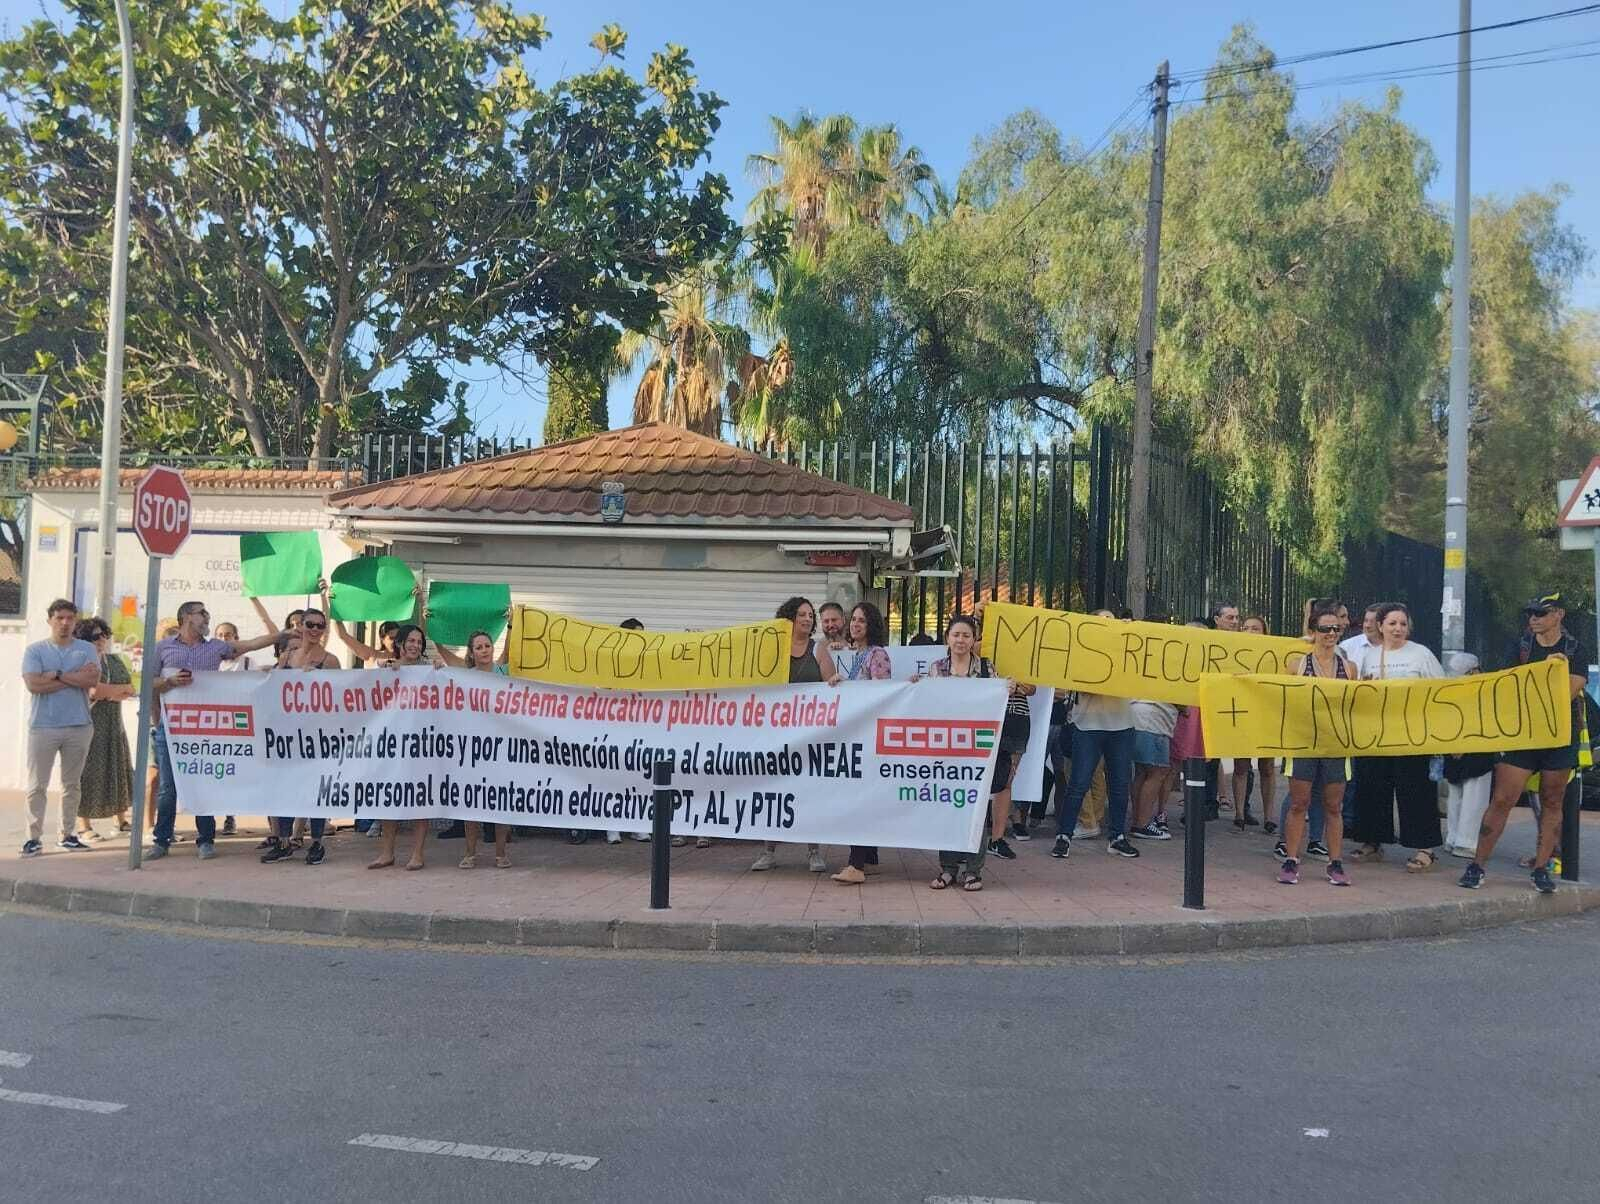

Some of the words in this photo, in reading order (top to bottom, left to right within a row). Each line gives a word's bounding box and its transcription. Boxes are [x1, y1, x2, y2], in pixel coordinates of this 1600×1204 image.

[140, 492, 188, 533] STOP
[160, 579, 191, 591] OETA
[517, 607, 663, 680] BAJADA
[671, 641, 696, 662] DE
[993, 614, 1114, 684] MÁS
[282, 681, 339, 713] CC.OO.
[343, 687, 367, 712] en
[371, 678, 440, 711] defensa
[444, 679, 465, 711] de
[469, 685, 490, 712] un
[494, 683, 569, 719] sistema
[572, 691, 664, 723] educativo
[667, 690, 737, 731] público
[742, 694, 766, 727] de
[770, 694, 841, 728] calidad
[1217, 697, 1249, 727] +
[264, 727, 293, 759] Por
[298, 728, 315, 759] la
[319, 727, 373, 766] bajada
[377, 726, 397, 759] de
[401, 725, 454, 759] ratios
[458, 732, 468, 767] y
[471, 735, 503, 768] por
[508, 736, 540, 764] una
[544, 733, 619, 770] atención
[681, 742, 700, 775] al
[703, 742, 802, 776] alumnado
[807, 742, 863, 778] NEAE
[883, 726, 972, 749] CCOO
[316, 771, 350, 808] Más
[354, 773, 434, 814] personal
[439, 774, 460, 808] de
[464, 777, 563, 815] orientación
[704, 790, 729, 825] AL
[734, 798, 747, 834] y
[750, 791, 796, 829] PTIS
[899, 783, 979, 808] málaga
